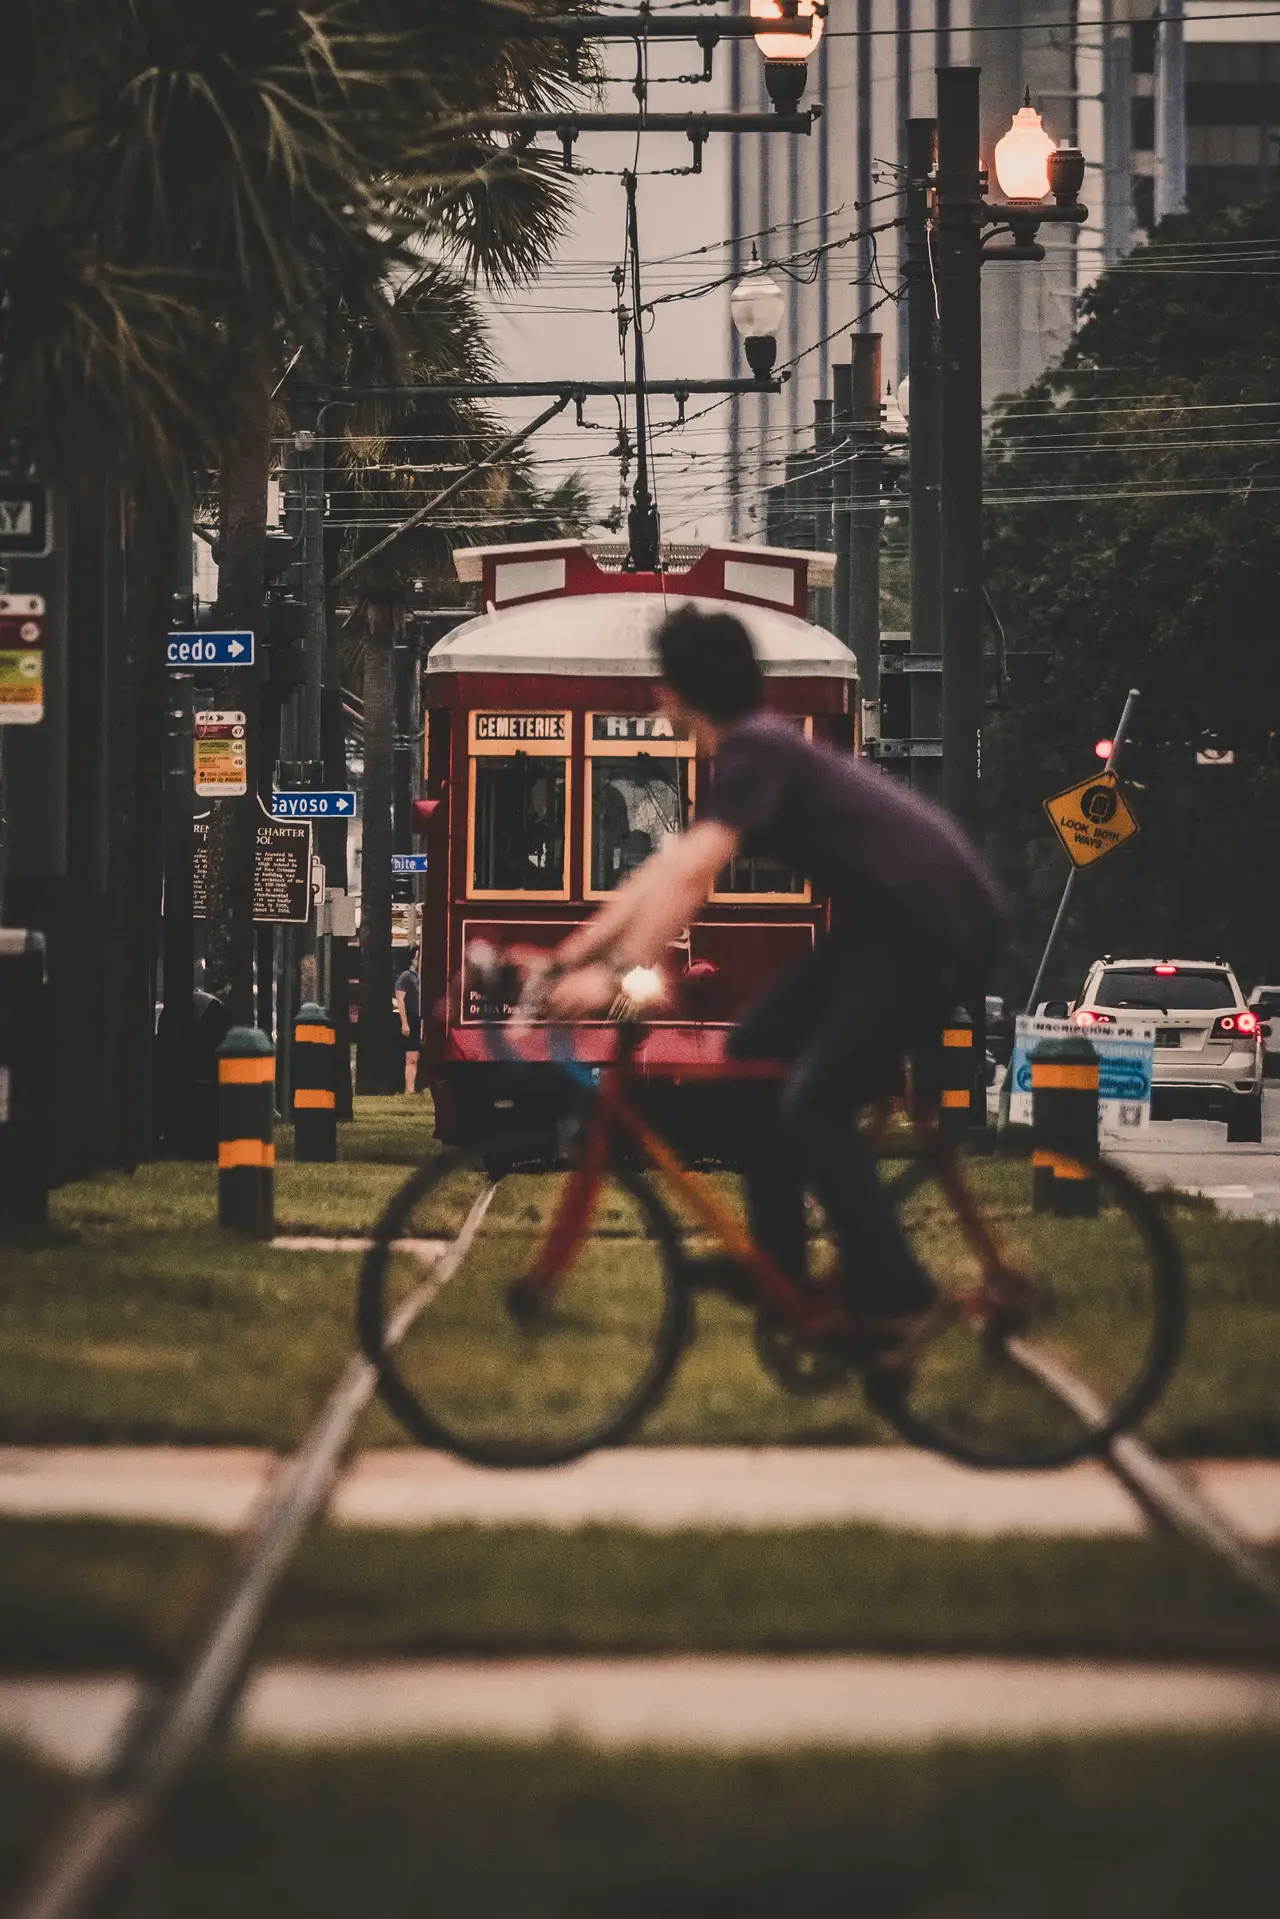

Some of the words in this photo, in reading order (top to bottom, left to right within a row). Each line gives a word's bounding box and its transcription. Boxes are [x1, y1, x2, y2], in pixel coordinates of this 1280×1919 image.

[168, 638, 217, 661] cedo
[479, 717, 565, 738] CEMETERIES
[607, 716, 675, 737] RTA
[257, 827, 305, 838] CHARTER
[1061, 816, 1089, 834] LOOK
[1093, 827, 1120, 841] BOTH
[391, 857, 417, 870] hite
